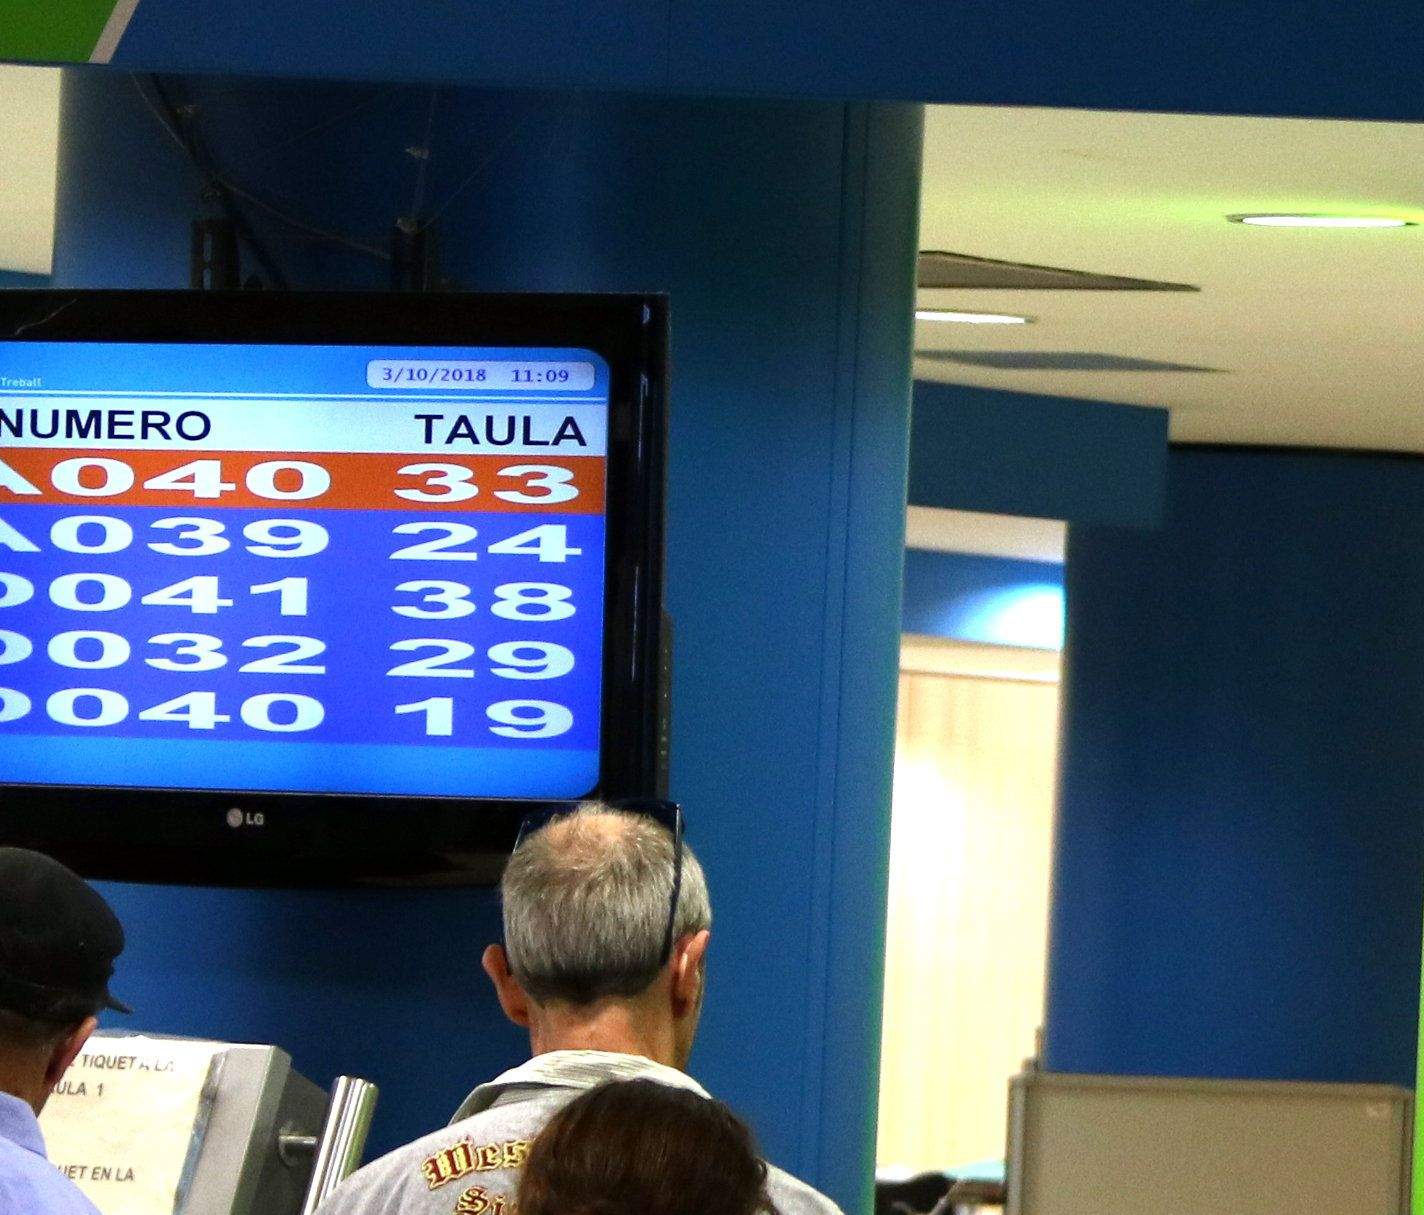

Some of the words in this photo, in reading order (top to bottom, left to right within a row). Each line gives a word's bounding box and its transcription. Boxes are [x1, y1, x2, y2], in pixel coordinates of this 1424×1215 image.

[0, 377, 42, 388] Treball
[382, 367, 487, 383] 3/10/2018
[511, 368, 570, 383] 11:09
[414, 414, 588, 447] TAULA
[393, 462, 580, 505] 33
[388, 521, 582, 563] 24
[390, 579, 577, 622] 38
[385, 638, 576, 681] 29
[394, 696, 574, 739] 19
[246, 812, 264, 825] LG
[82, 1054, 137, 1070] TIQUET
[50, 1081, 87, 1096] ULA
[97, 1083, 104, 1097] 1
[91, 1166, 112, 1181] EN
[115, 1167, 134, 1182] LA
[422, 1135, 532, 1191] Wes
